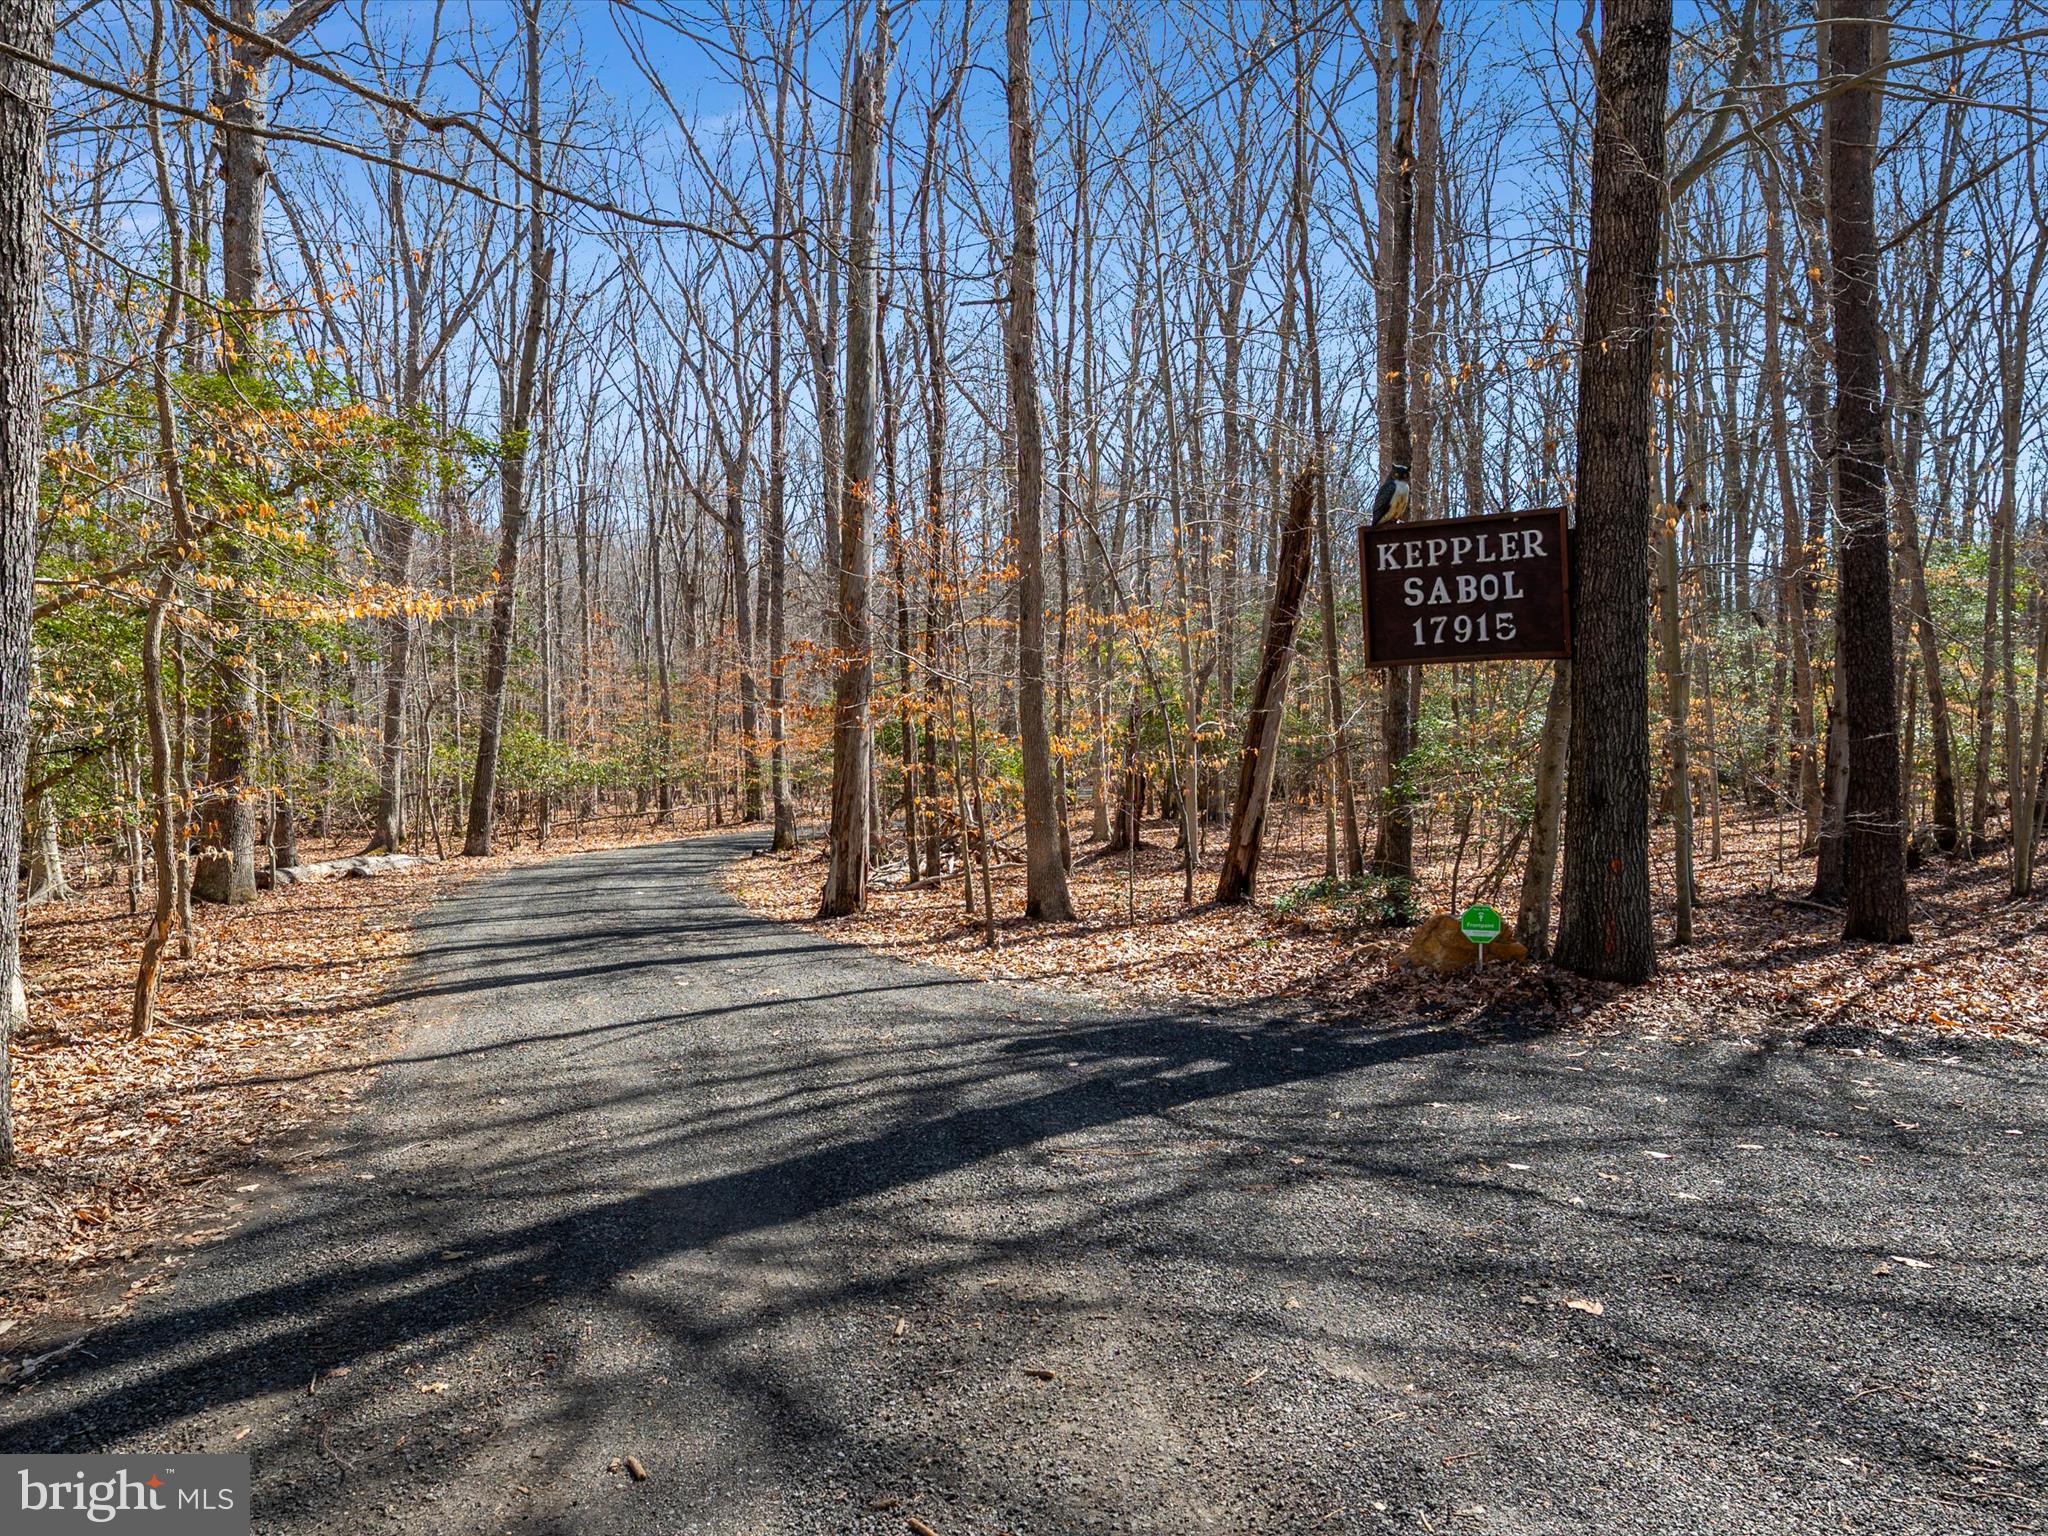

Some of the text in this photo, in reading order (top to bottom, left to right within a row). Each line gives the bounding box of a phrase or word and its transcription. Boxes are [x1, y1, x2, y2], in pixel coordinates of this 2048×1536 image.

[1376, 529, 1548, 571] KEPPLER
[1403, 570, 1524, 607] SABOL
[1412, 612, 1517, 646] 17915
